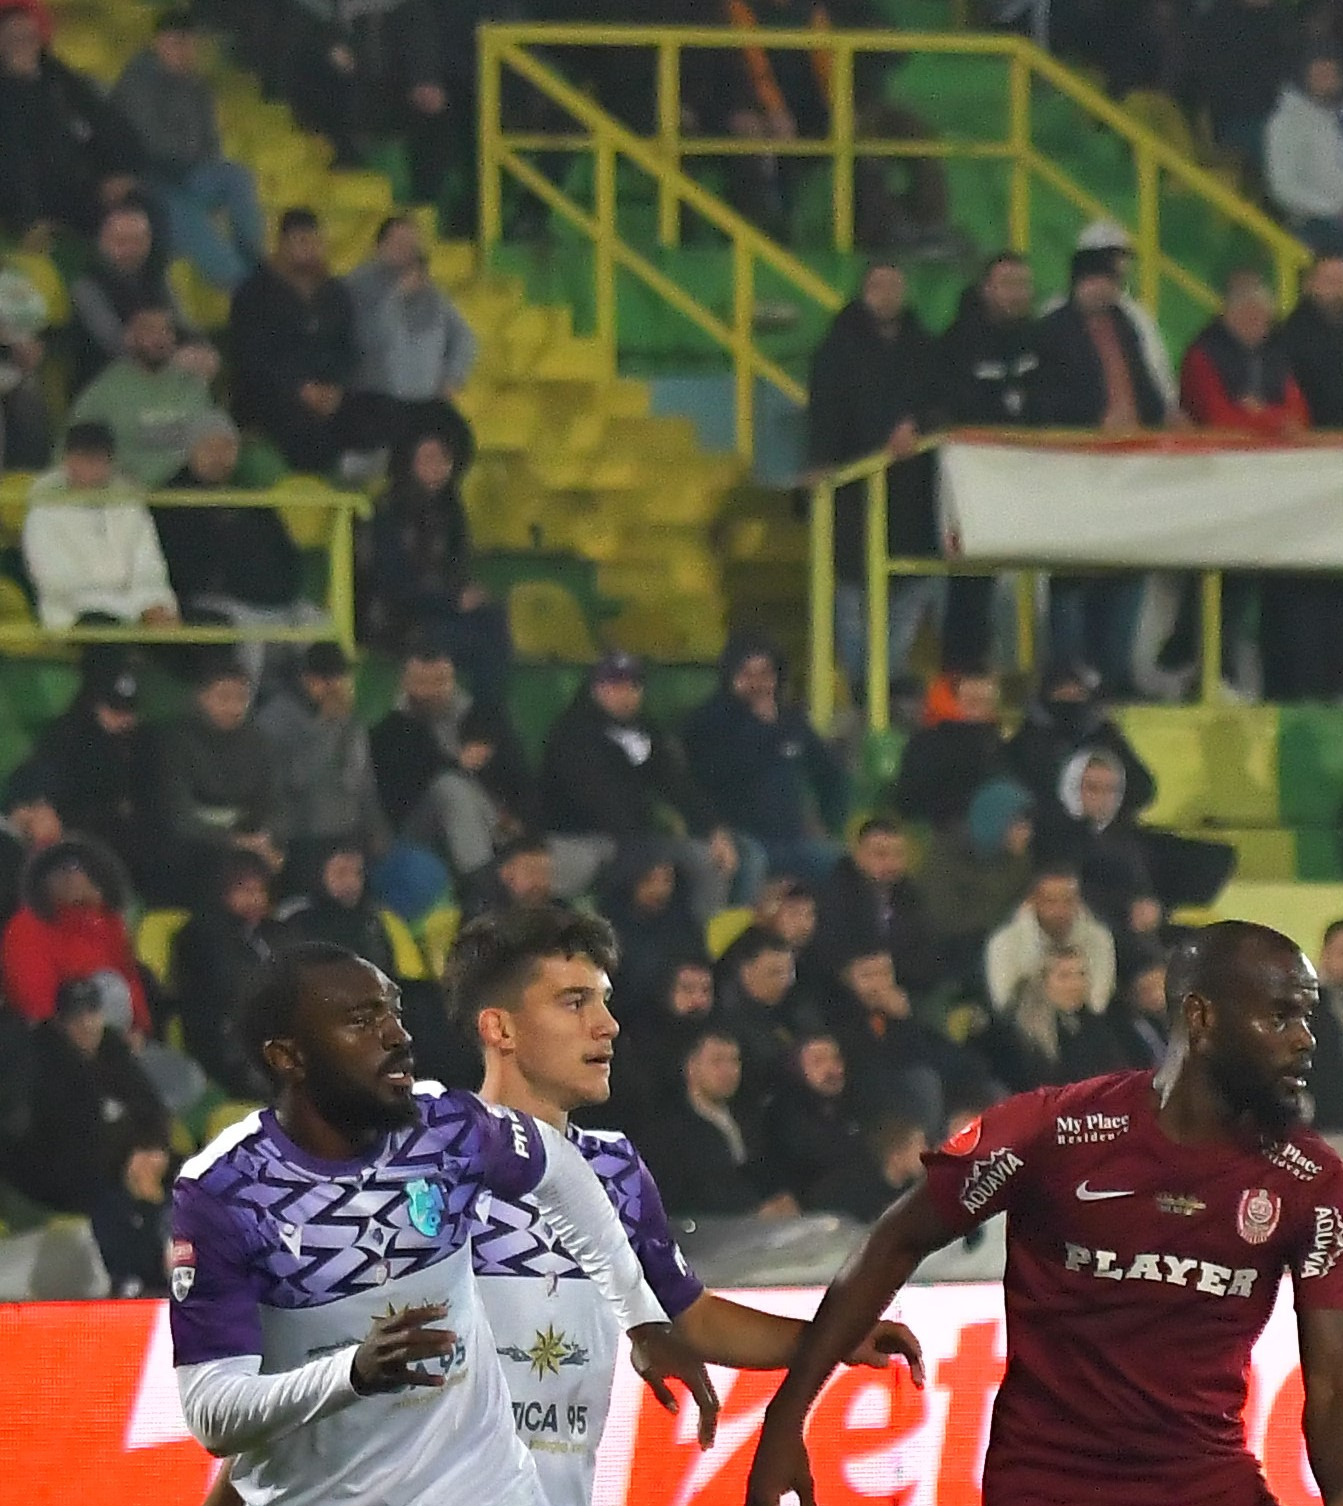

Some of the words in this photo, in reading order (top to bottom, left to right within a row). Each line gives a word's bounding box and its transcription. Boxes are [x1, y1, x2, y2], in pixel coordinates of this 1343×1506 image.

[1056, 1115, 1083, 1135] My
[1085, 1112, 1130, 1130] Place
[1063, 1241, 1259, 1299] PLAYER
[567, 1404, 588, 1436] 95
